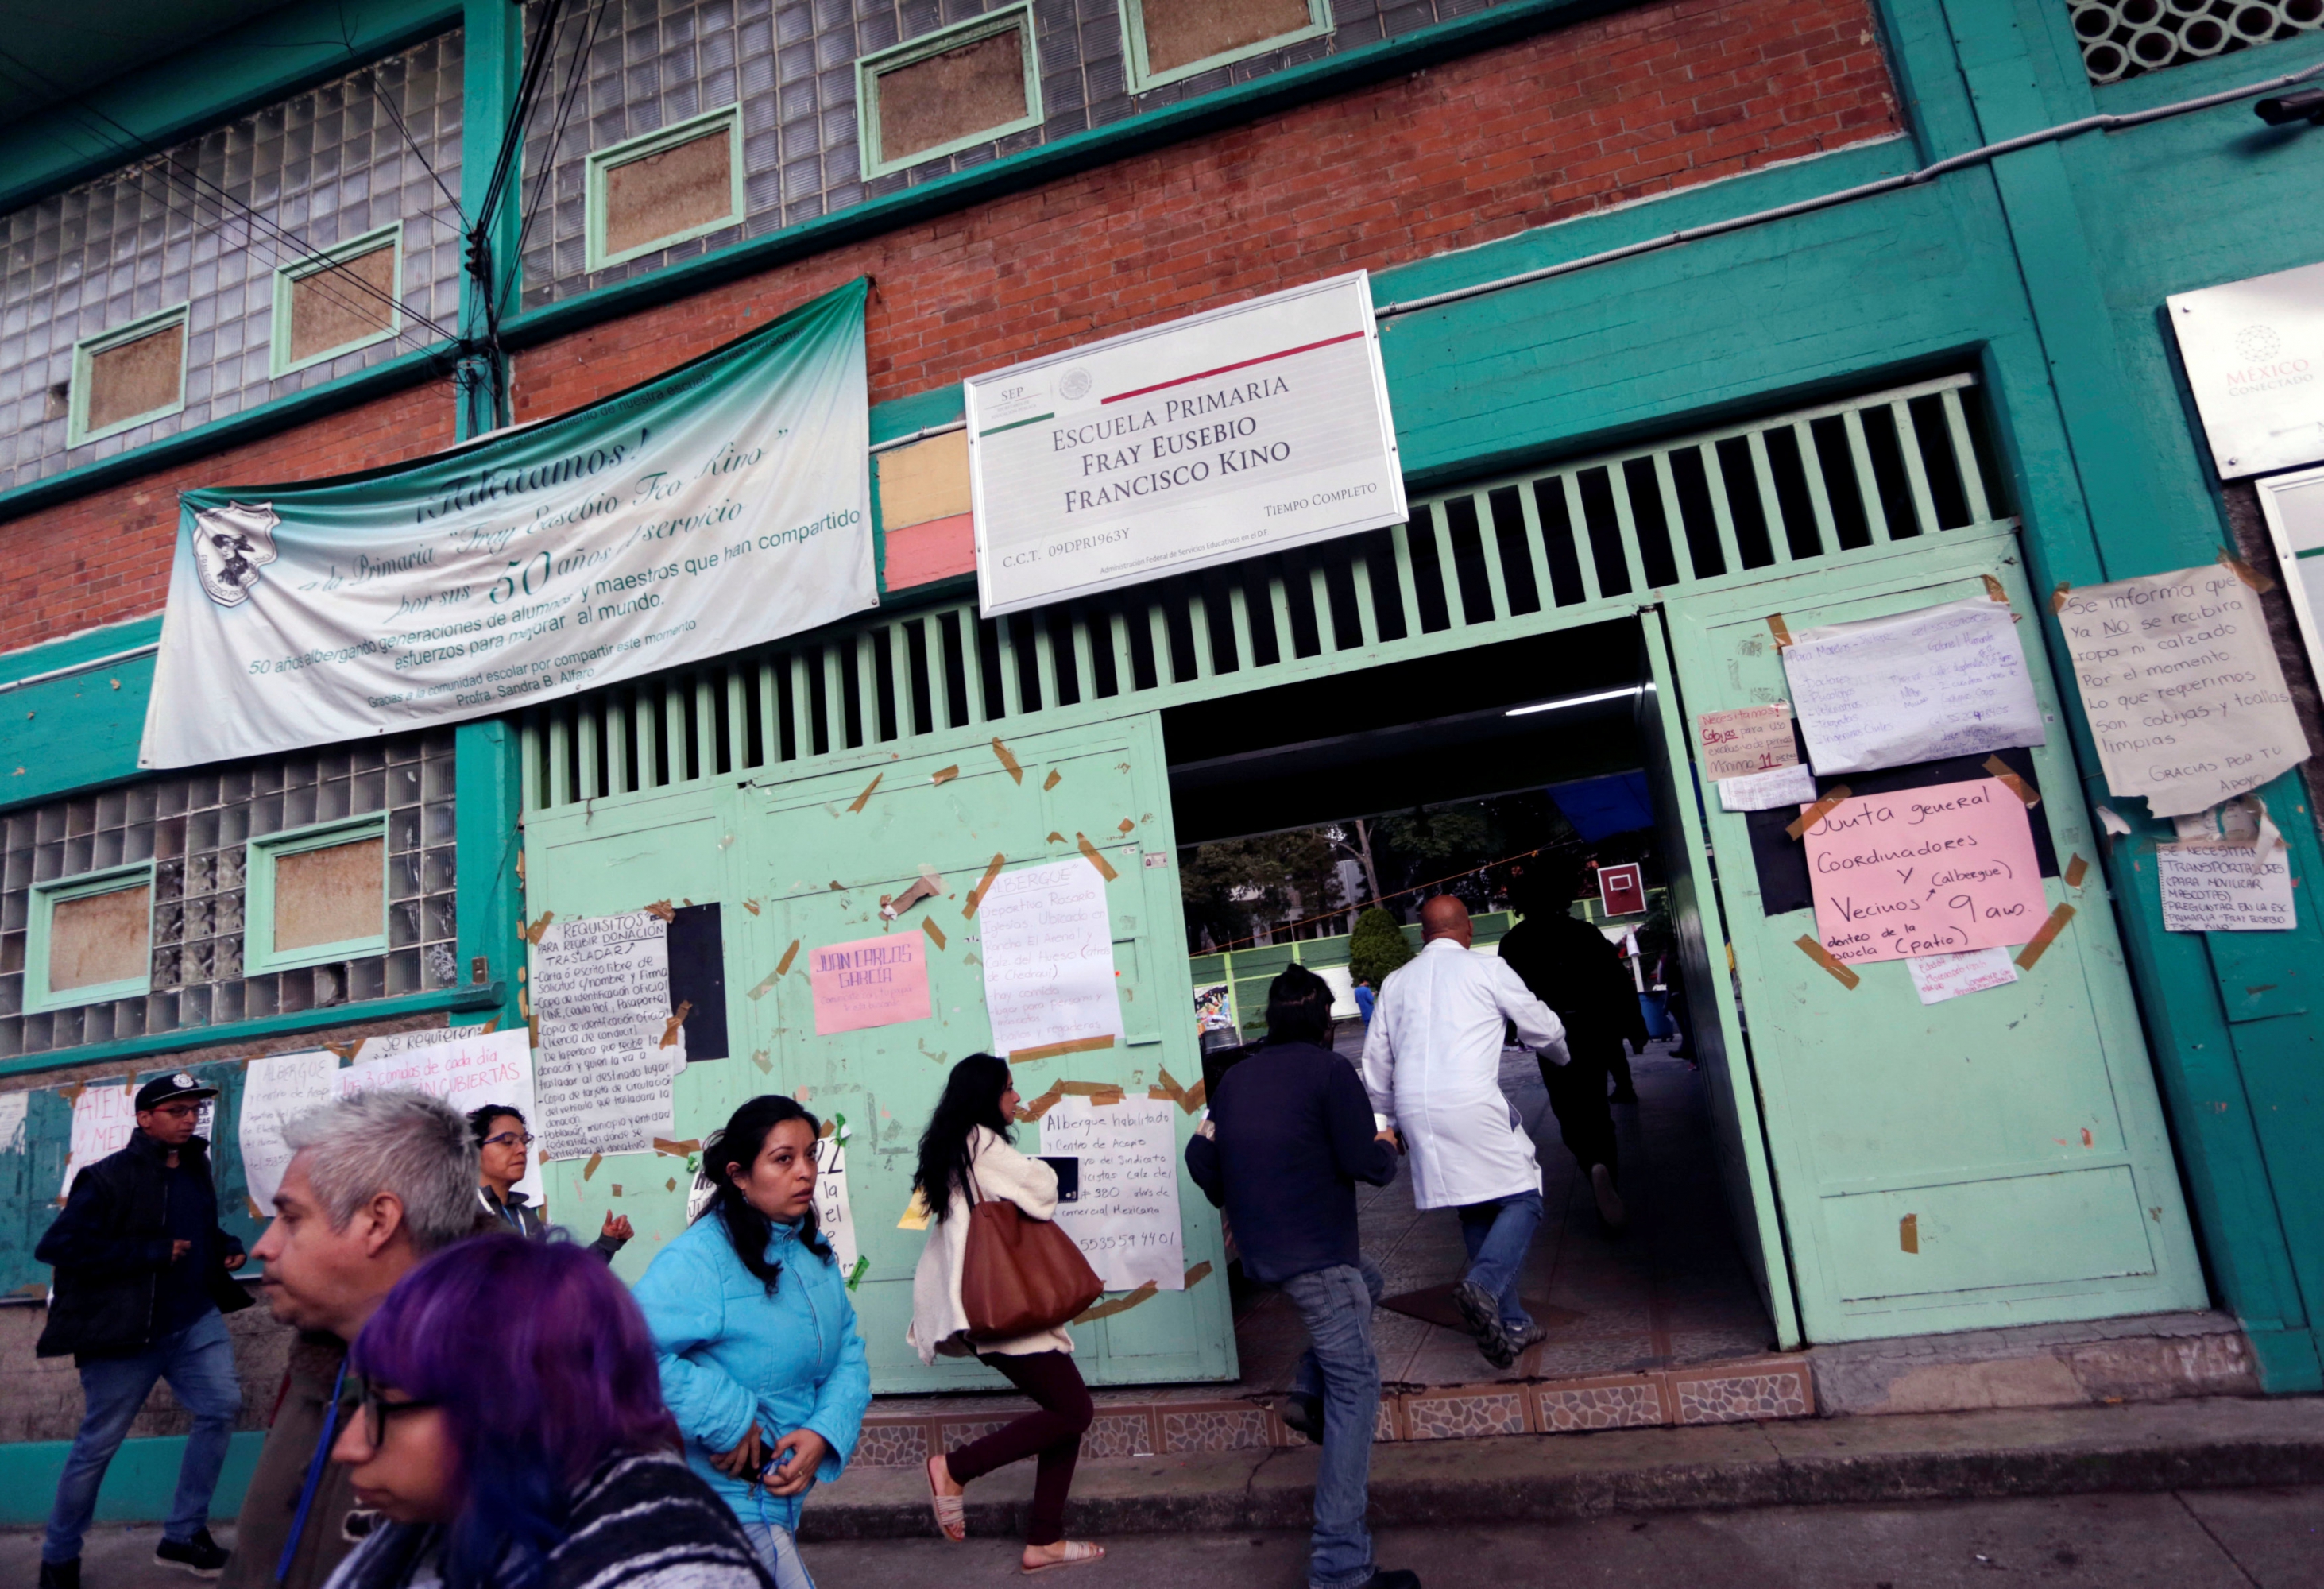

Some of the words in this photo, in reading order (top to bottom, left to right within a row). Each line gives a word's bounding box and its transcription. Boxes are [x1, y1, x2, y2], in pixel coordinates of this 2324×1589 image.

[2226, 358, 2309, 387] MÉXICO
[2229, 373, 2314, 398] CONECTADO
[617, 390, 665, 412] nuestra
[667, 373, 713, 396] escuela
[1001, 387, 1023, 401] SEP
[1052, 410, 1157, 452] ESCUELA
[1165, 376, 1290, 422] PRIMARIA
[1081, 444, 1142, 477] FRAY
[1151, 416, 1257, 461] EUSEBIO
[1065, 461, 1210, 513] FRANCISCO
[1219, 440, 1291, 475] KINO
[1264, 498, 1309, 518] TIEMPO
[1312, 481, 1378, 508] COMPLETO
[349, 543, 435, 586] Primaria
[527, 490, 622, 535] Eusebio
[633, 470, 685, 506] Fco
[383, 593, 435, 624] por
[439, 585, 473, 607] sus
[489, 550, 551, 604] 50
[556, 543, 611, 577] años
[642, 498, 745, 542] servicio
[1002, 550, 1042, 568] C.C.T.
[1100, 558, 1146, 574] Administración
[1146, 552, 1168, 564] Federal
[1178, 543, 1206, 556] Servicios
[1206, 535, 1240, 550] Educativos
[1251, 531, 1257, 539] el
[249, 659, 270, 675] 50
[275, 655, 304, 674] años
[304, 639, 377, 667] albergando
[378, 618, 482, 654] generaciones
[486, 611, 507, 628] de
[512, 593, 572, 624] alumnos
[581, 584, 591, 603] y
[595, 560, 679, 597] maestros
[684, 553, 719, 577] que
[724, 539, 752, 563] han
[758, 508, 861, 551] compartido
[2067, 595, 2098, 616] Se
[2108, 585, 2196, 610] informa
[2205, 575, 2237, 598] que
[394, 642, 466, 671] esfuerzos
[469, 634, 505, 658] para
[509, 614, 566, 645] mejorar
[578, 606, 593, 627] al
[597, 592, 665, 621] mundo.
[2071, 624, 2091, 639] Ya
[2103, 619, 2132, 636] NO
[2140, 617, 2163, 631] se
[2171, 600, 2244, 625] recibira
[2077, 647, 2119, 664] ropa
[2131, 642, 2146, 655] ni
[2156, 624, 2237, 651] calzado
[368, 690, 404, 709] Gracias
[415, 687, 427, 700] la
[427, 671, 483, 696] comunidad
[485, 662, 528, 683] escolar
[531, 659, 551, 674] por
[554, 643, 615, 668] compartir
[616, 636, 641, 653] este
[644, 618, 697, 646] momento
[2082, 675, 2111, 688] Por
[2123, 668, 2138, 681] el
[2145, 649, 2231, 677] momento
[456, 685, 496, 707] Profra.
[497, 677, 541, 698] Sandra
[543, 674, 556, 687] B.
[559, 667, 595, 684] Alfaro
[2088, 698, 2109, 710] Lo
[2117, 692, 2149, 711] que
[2157, 670, 2256, 700] requerimos
[2096, 718, 2128, 734] Son
[2142, 704, 2210, 728] cobijas
[2218, 701, 2228, 717] y
[2234, 689, 2290, 708] toallas
[1740, 725, 1764, 739] para
[1769, 721, 1786, 732] uso
[1753, 737, 1764, 749] de
[2101, 732, 2177, 754] limpias
[1758, 752, 1777, 769] 11
[2148, 761, 2218, 783] GRACIAS
[2225, 754, 2254, 768] POR
[2259, 747, 2282, 760] TU
[2219, 774, 2264, 793] APOYO
[1808, 802, 1895, 836] Junta
[1908, 786, 1990, 825] general
[1816, 834, 1978, 875] Coordinadores
[2161, 847, 2179, 857] SE
[1931, 859, 2013, 887] (albergue)
[2166, 876, 2200, 887] (PARA
[980, 899, 1043, 919] Deportivo
[1830, 895, 1921, 922] Vecinos
[1947, 894, 1977, 923] 9
[2166, 901, 2236, 913] PREGUNTAR
[2238, 903, 2253, 913] EN
[2256, 903, 2268, 913] LA
[2167, 889, 2232, 903] MASCOTAS)
[1038, 907, 1088, 925] Ubicado
[1091, 910, 1105, 920] en
[2167, 913, 2216, 923] PRIMARIA
[537, 941, 559, 955] PARA
[602, 922, 664, 945] DONACIÓN
[1827, 932, 1871, 949] dentro
[1881, 927, 1896, 938] de
[1904, 923, 1916, 934] la
[545, 945, 624, 968] TRASLADAR
[574, 963, 605, 978] escrito
[606, 957, 632, 973] libre
[637, 954, 654, 968] de
[816, 952, 852, 973] JUAN
[854, 943, 912, 968] CARLOS
[630, 973, 636, 985] y
[838, 967, 892, 989] GARCÍA
[383, 1034, 401, 1053] Se
[366, 1071, 375, 1089] 3
[423, 1057, 440, 1077] de
[444, 1049, 472, 1071] cada
[476, 1045, 498, 1065] día
[439, 1061, 520, 1096] CUBIERTAS
[1046, 1114, 1107, 1137] Albergue
[1112, 1111, 1170, 1128] habilitado
[1055, 1139, 1088, 1151] Centro
[1092, 1138, 1106, 1150] de
[1100, 1156, 1114, 1165] del
[1119, 1154, 1167, 1166] Sindicato
[1153, 1167, 1172, 1179] del
[824, 1181, 838, 1199] la
[1156, 1185, 1170, 1197] de
[826, 1204, 842, 1223] el
[1113, 1203, 1161, 1216] Mexicana
